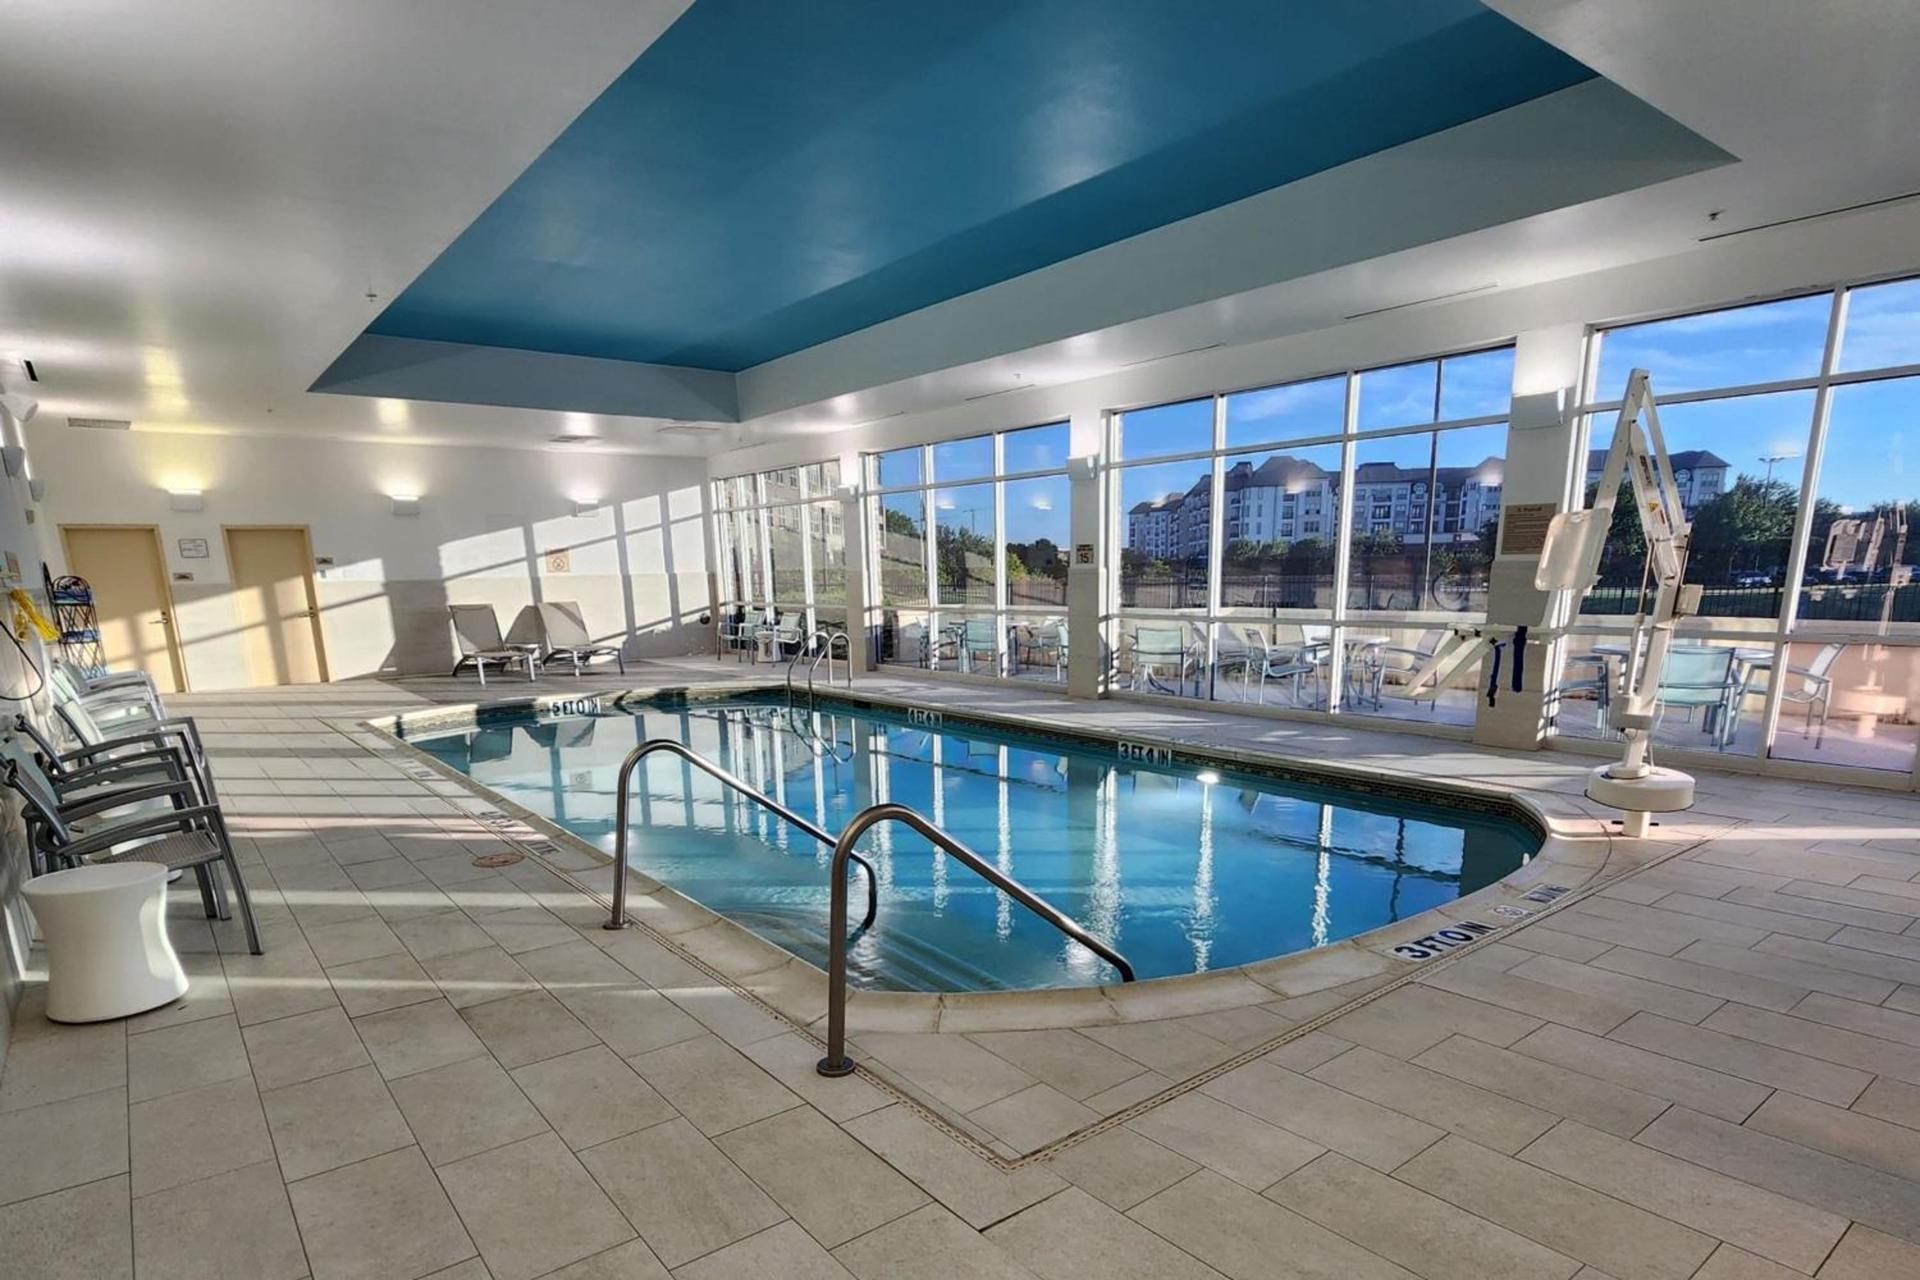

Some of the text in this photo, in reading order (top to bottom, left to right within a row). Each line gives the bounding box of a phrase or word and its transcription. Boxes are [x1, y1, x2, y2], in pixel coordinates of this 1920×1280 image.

[552, 702, 560, 716] 5
[1120, 743, 1129, 759] 3
[1394, 945, 1432, 960] 3
